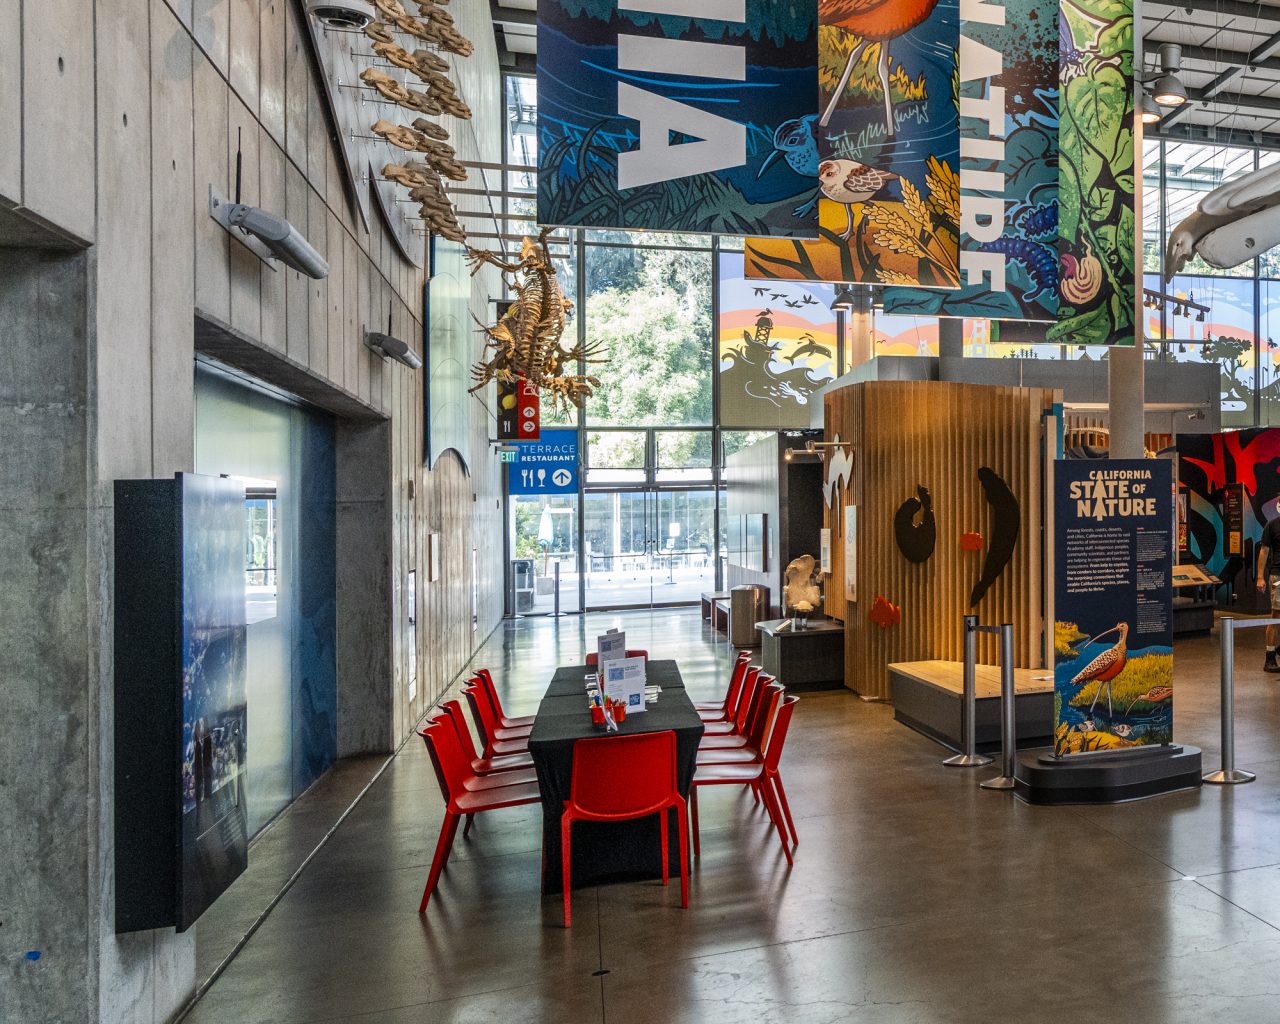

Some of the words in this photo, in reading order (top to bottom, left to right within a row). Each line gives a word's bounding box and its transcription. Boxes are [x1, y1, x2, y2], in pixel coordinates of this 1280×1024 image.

[521, 444, 575, 453] TERRACE
[501, 451, 516, 462] EXIT
[1089, 469, 1152, 480] CALIFORNIA
[1069, 480, 1130, 499] STATE
[1132, 483, 1147, 494] OF
[1077, 498, 1157, 519] NATURE
